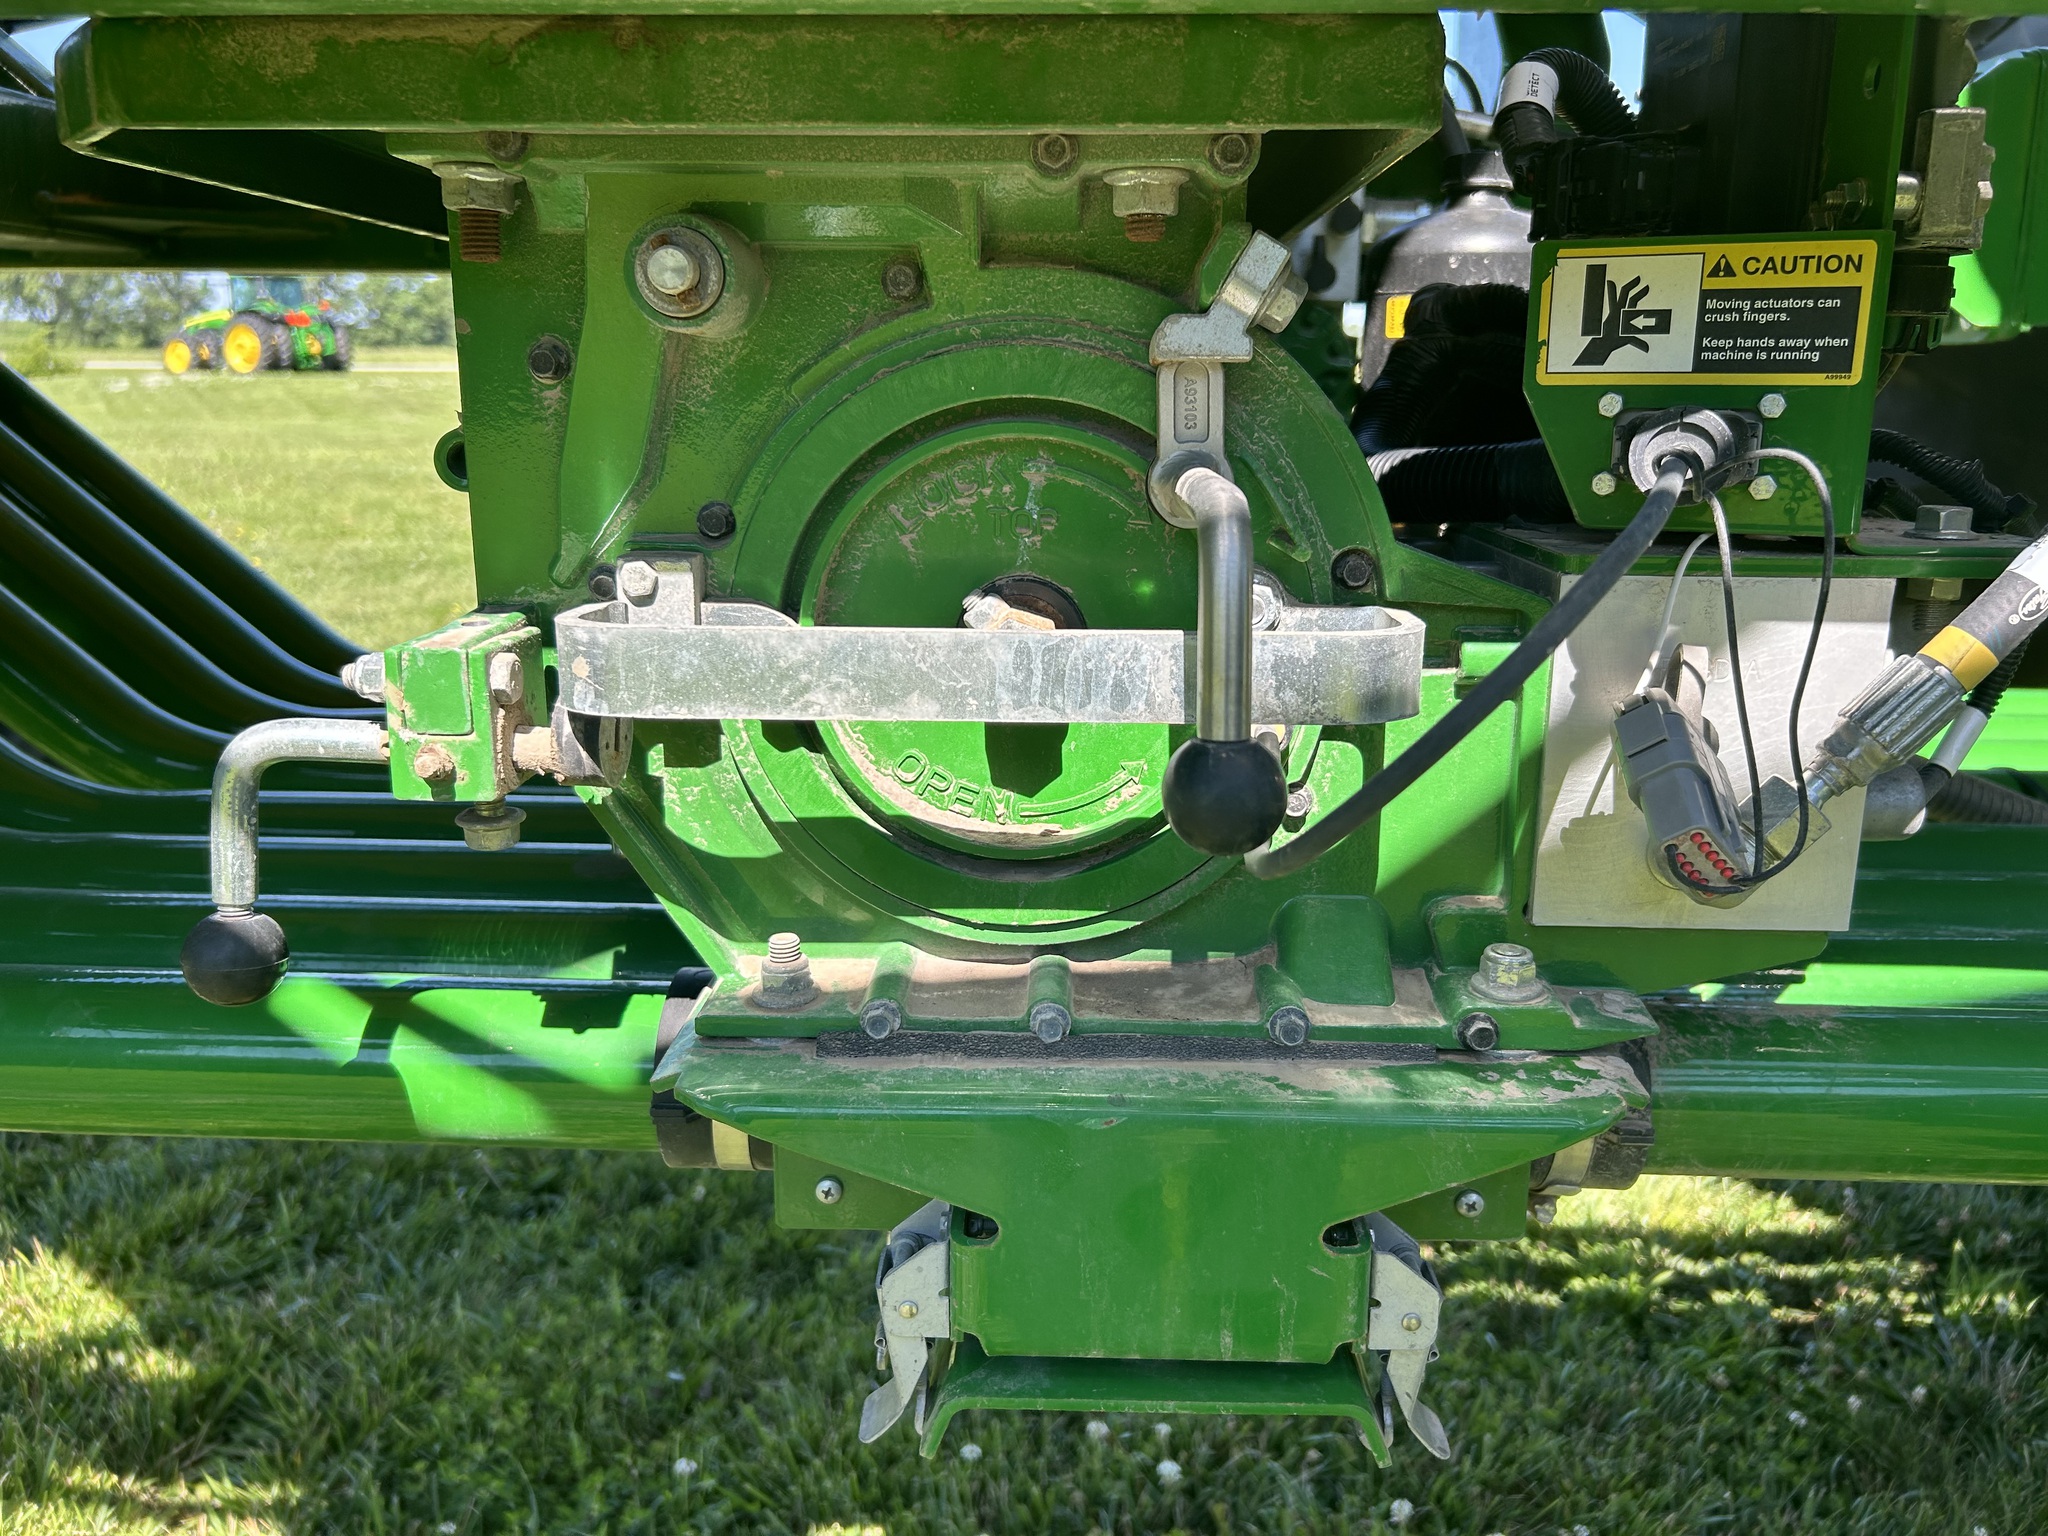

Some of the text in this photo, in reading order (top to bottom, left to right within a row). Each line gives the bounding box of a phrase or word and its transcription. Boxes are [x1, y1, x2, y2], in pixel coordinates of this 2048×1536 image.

[1530, 73, 1540, 97] DETECT
[1742, 253, 1863, 276] CAUTION
[1706, 298, 1841, 311] Moving actuators can
[1704, 311, 1790, 324] crush fingers.
[1702, 336, 1849, 349] Keep hands away when
[1701, 349, 1820, 362] machine is running
[1184, 376, 1198, 430] A93103
[886, 453, 1015, 533] LOCK
[987, 507, 1058, 539] TOP
[893, 750, 1014, 825] OPEN
